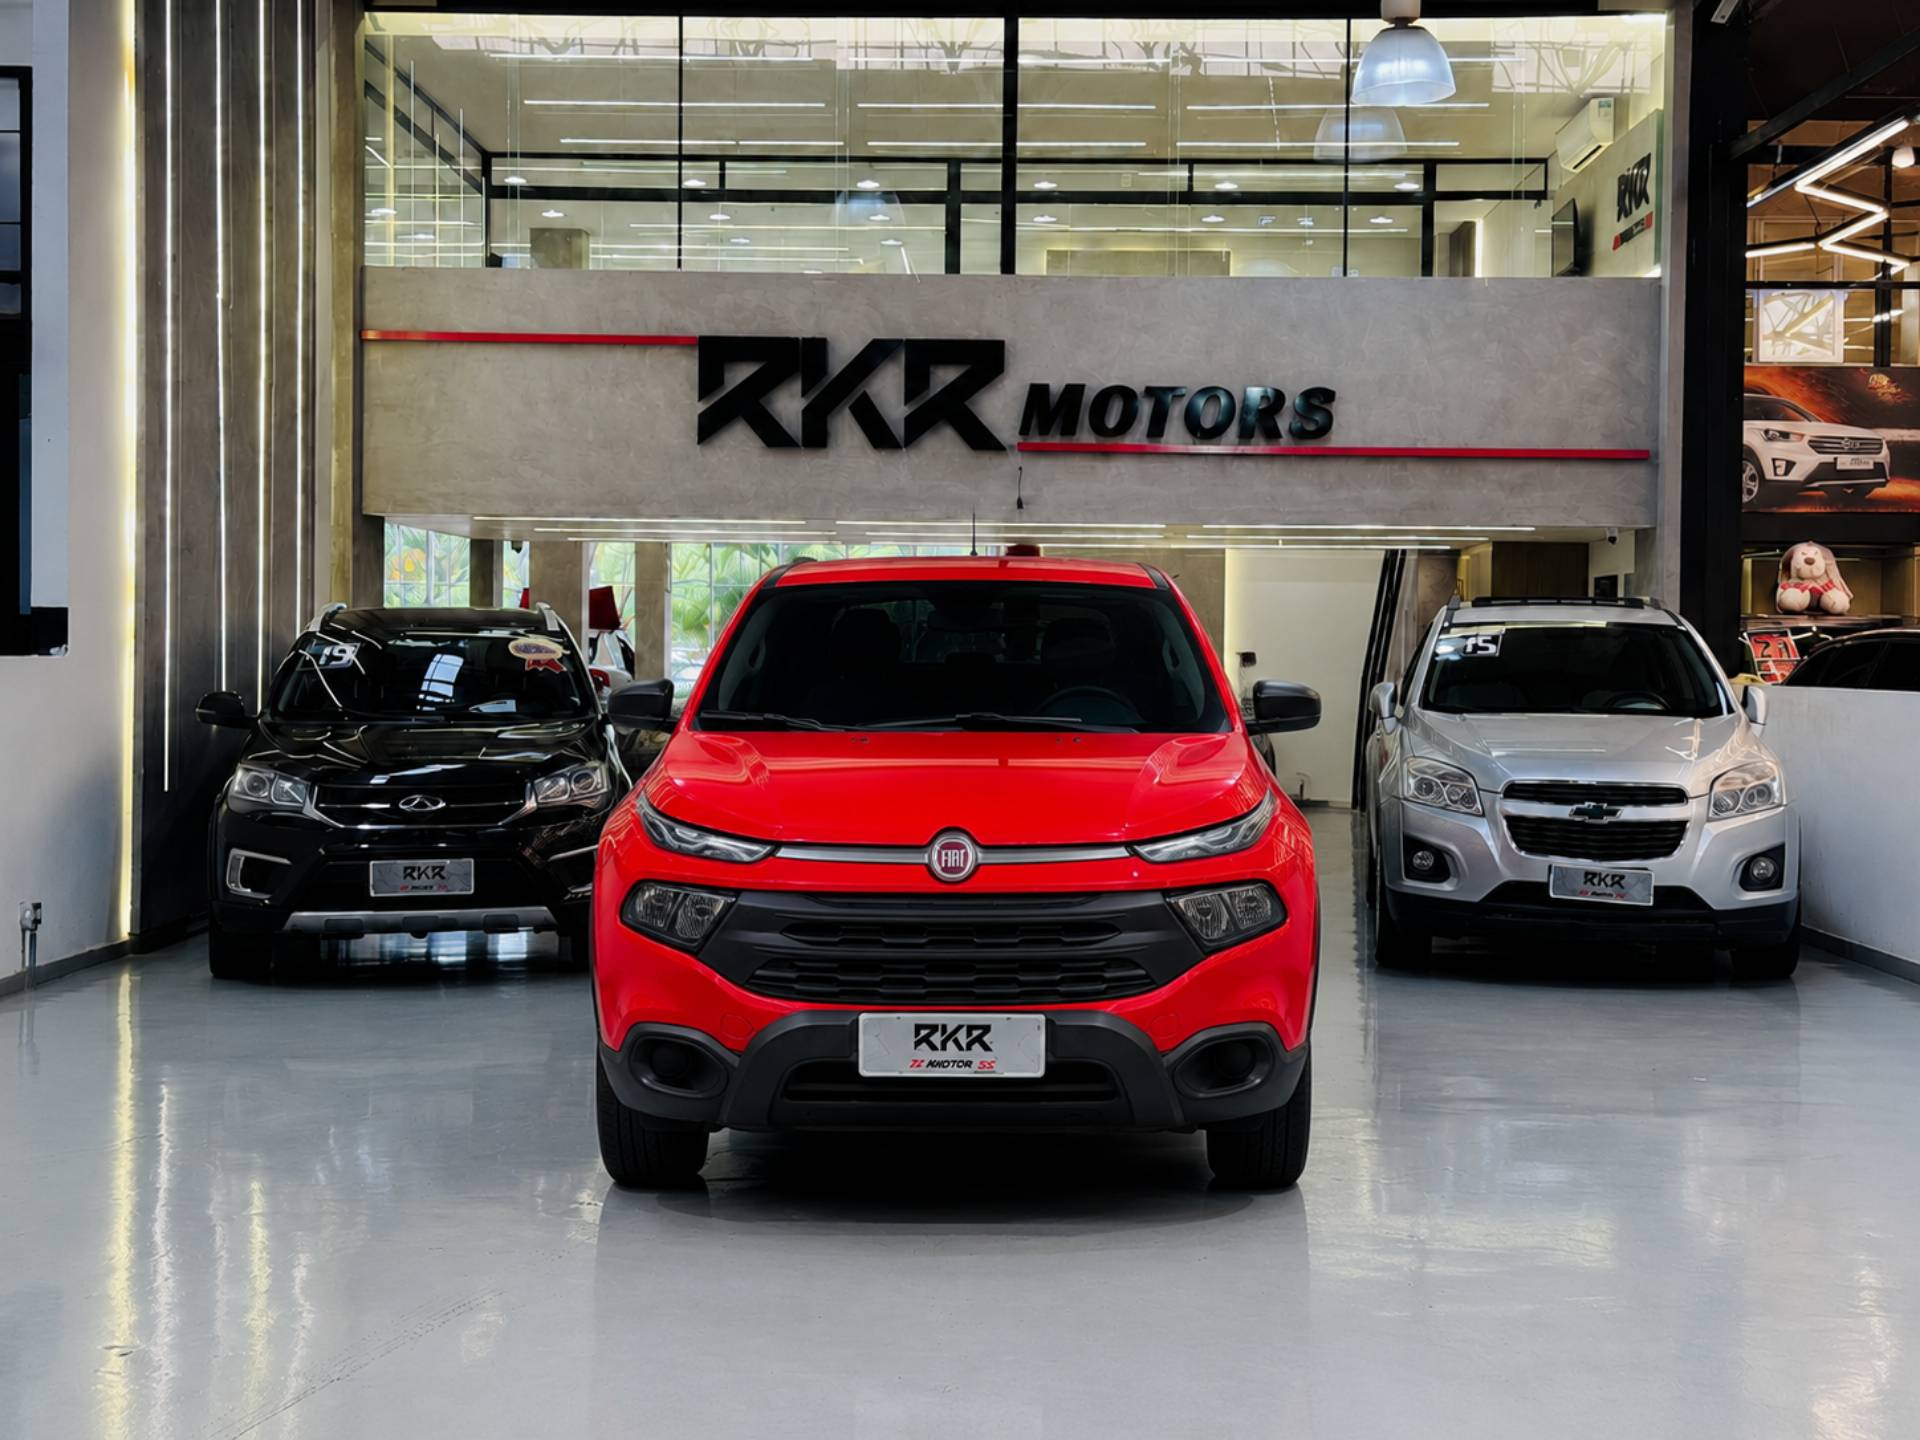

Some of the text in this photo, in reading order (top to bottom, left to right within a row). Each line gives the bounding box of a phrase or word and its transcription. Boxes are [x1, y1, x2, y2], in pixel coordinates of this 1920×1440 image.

[697, 336, 1336, 450] RKR MOTORS
[942, 849, 965, 867] FIAT
[403, 865, 446, 880] RKR
[1583, 871, 1626, 889] RKR
[914, 1024, 993, 1052] RKR
